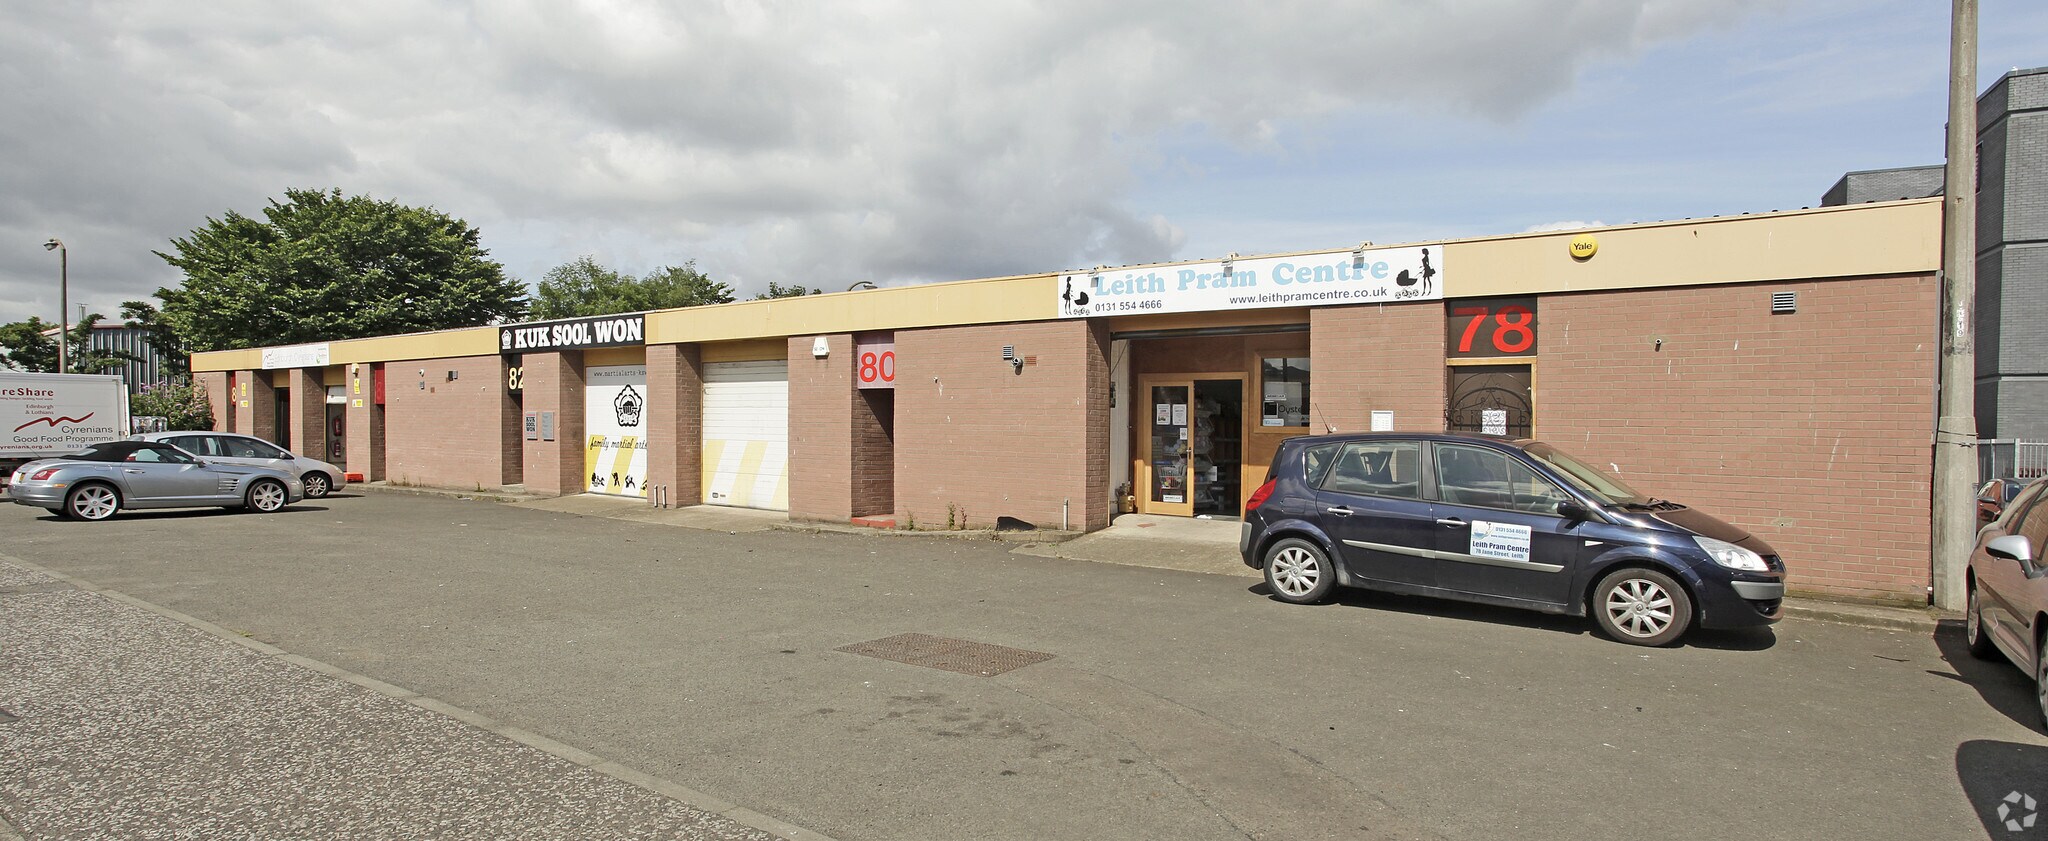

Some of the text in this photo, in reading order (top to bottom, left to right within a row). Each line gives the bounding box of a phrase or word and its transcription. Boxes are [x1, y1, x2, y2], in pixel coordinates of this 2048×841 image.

[1095, 260, 1389, 296] Leith Pram Centre
[1230, 286, 1387, 304] www.leithpramcentre.co.uk
[1095, 300, 1162, 312] 0131 554 4666
[514, 318, 643, 349] KUK SOOL WON
[1454, 305, 1534, 353] 78
[860, 351, 894, 382] 80
[61, 425, 114, 435] Cyrenians
[66, 435, 114, 443] Programme
[590, 437, 610, 451] family
[611, 438, 634, 449] martial
[1489, 542, 1506, 550] Pram
[1507, 544, 1529, 553] Centre
